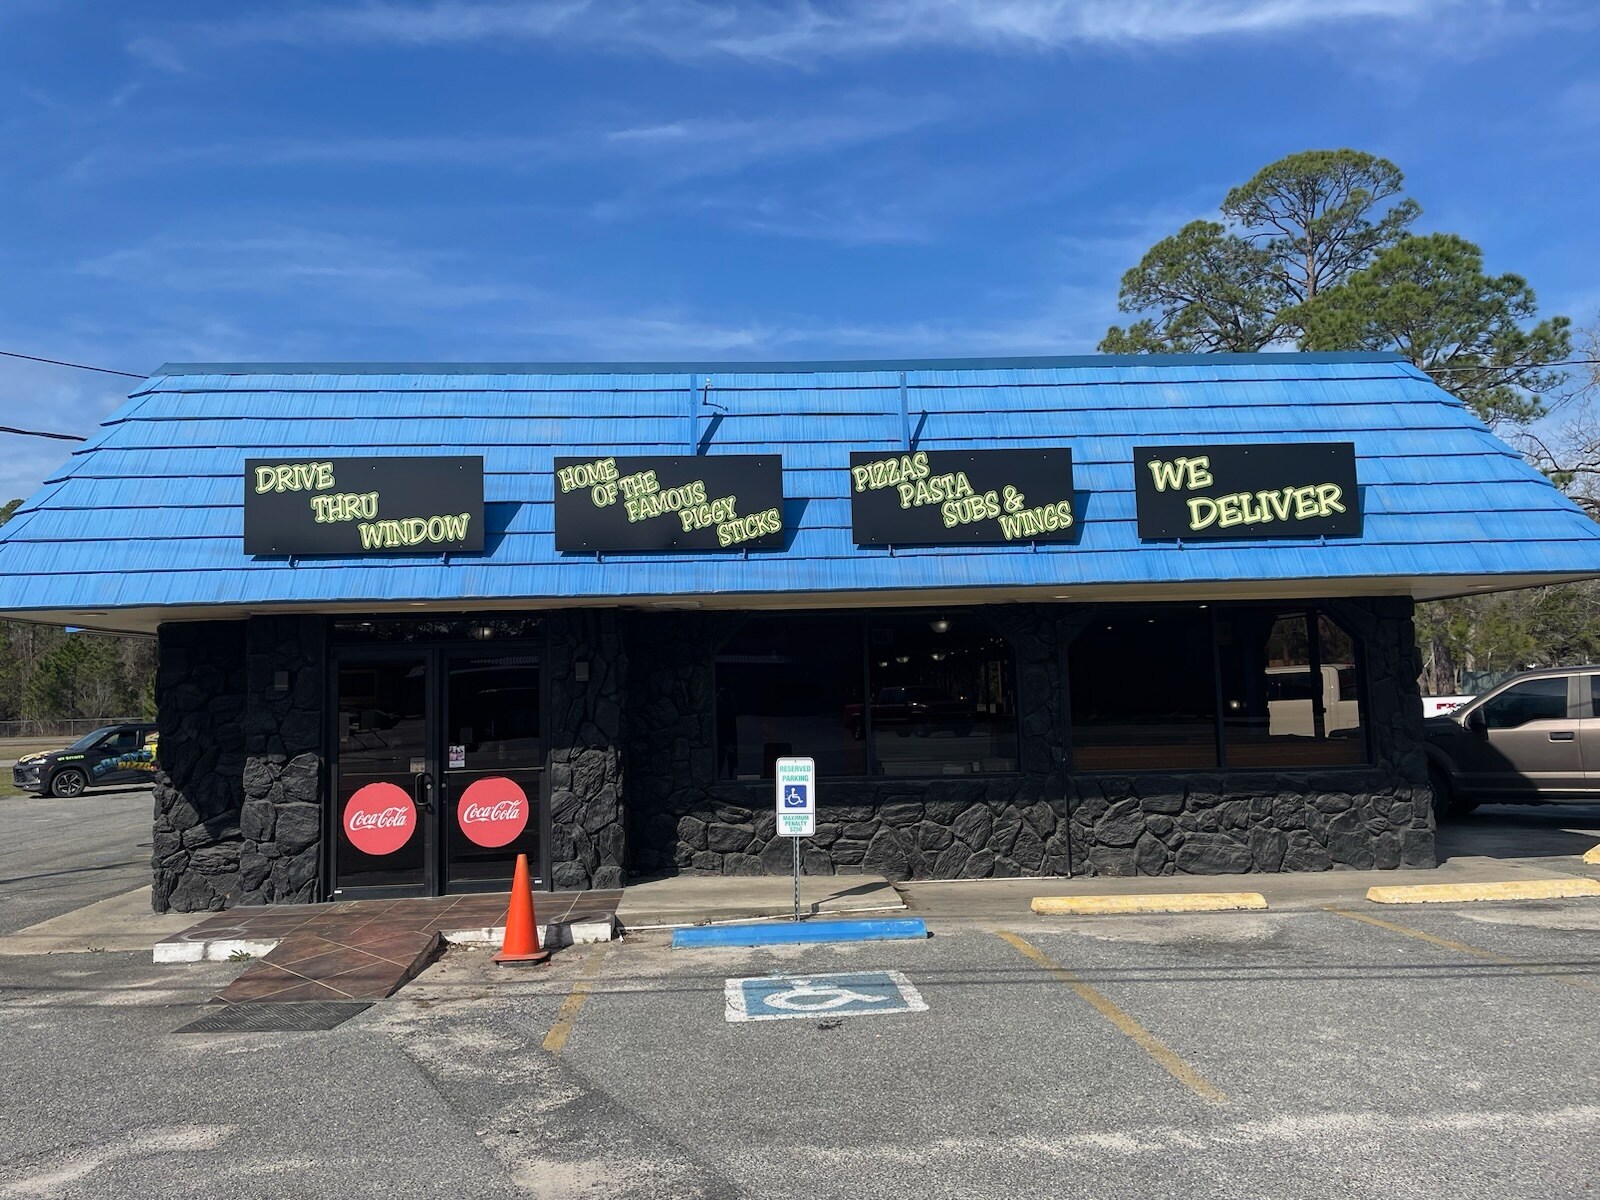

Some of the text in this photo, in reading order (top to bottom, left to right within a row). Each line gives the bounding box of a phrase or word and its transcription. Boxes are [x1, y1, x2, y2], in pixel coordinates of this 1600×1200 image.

[255, 462, 335, 494] DRIVE
[557, 457, 619, 493] HOME
[591, 470, 660, 507] OF THE
[851, 452, 930, 492] PIZZAS
[898, 472, 974, 509] PASTA
[1147, 456, 1213, 492] WE
[311, 492, 379, 523] THRU
[624, 480, 707, 523] FAMOUS
[678, 495, 737, 532] PIGGY
[941, 485, 1025, 528] SUBS &
[998, 500, 1073, 540] WINGS
[1187, 483, 1346, 531] DELIVER
[358, 513, 471, 549] WINDOW
[716, 508, 782, 547] STICKS
[349, 806, 410, 831] Coca-Cola
[463, 799, 523, 824] Coca-Cola
